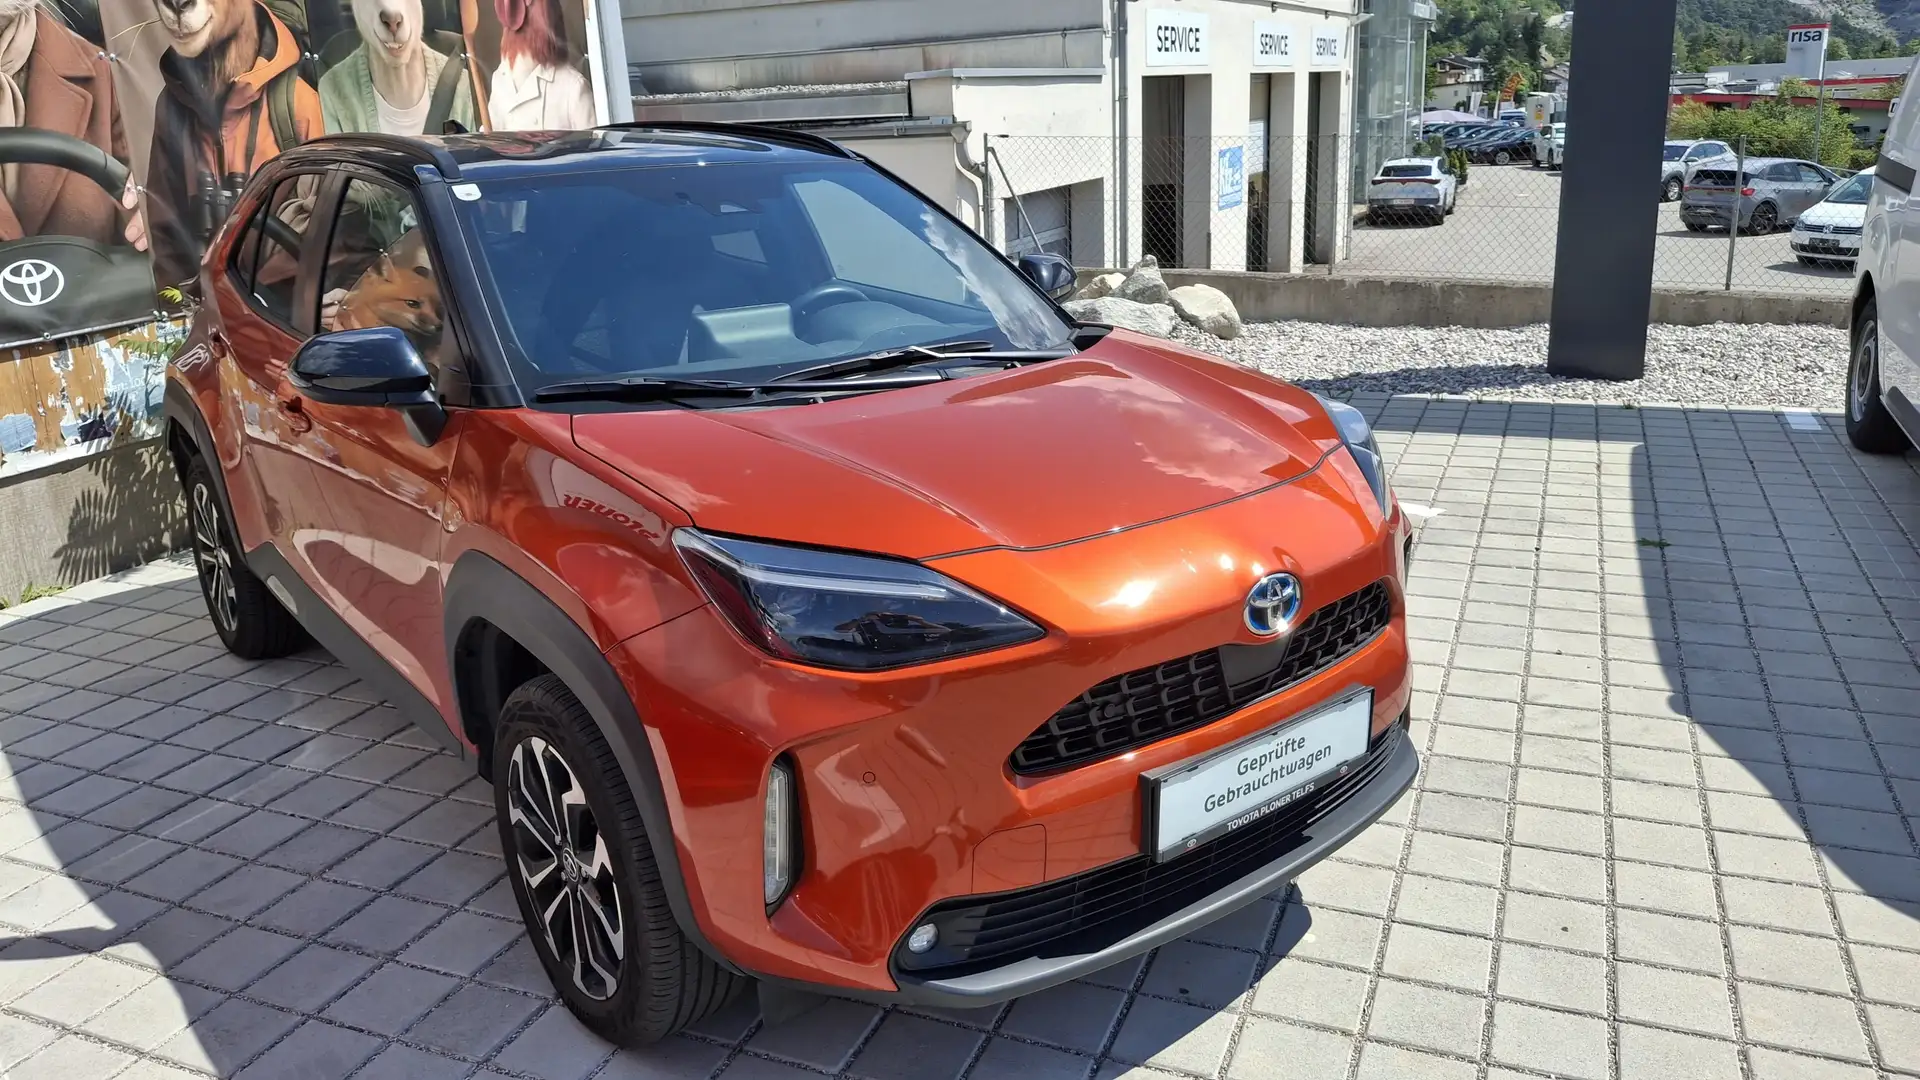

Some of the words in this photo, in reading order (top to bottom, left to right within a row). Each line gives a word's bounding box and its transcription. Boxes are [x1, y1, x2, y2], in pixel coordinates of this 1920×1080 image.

[1156, 25, 1201, 53] SERVICE
[1259, 33, 1289, 56] SERVICE
[1315, 37, 1337, 56] SERVICE
[1791, 30, 1822, 43] risa
[1237, 736, 1306, 776] Geprüfte
[1204, 745, 1332, 813] Gebrauchtwagen
[1227, 809, 1260, 831] TOYOTA
[1260, 793, 1291, 816] PLONER
[1291, 782, 1315, 801] TELFS
